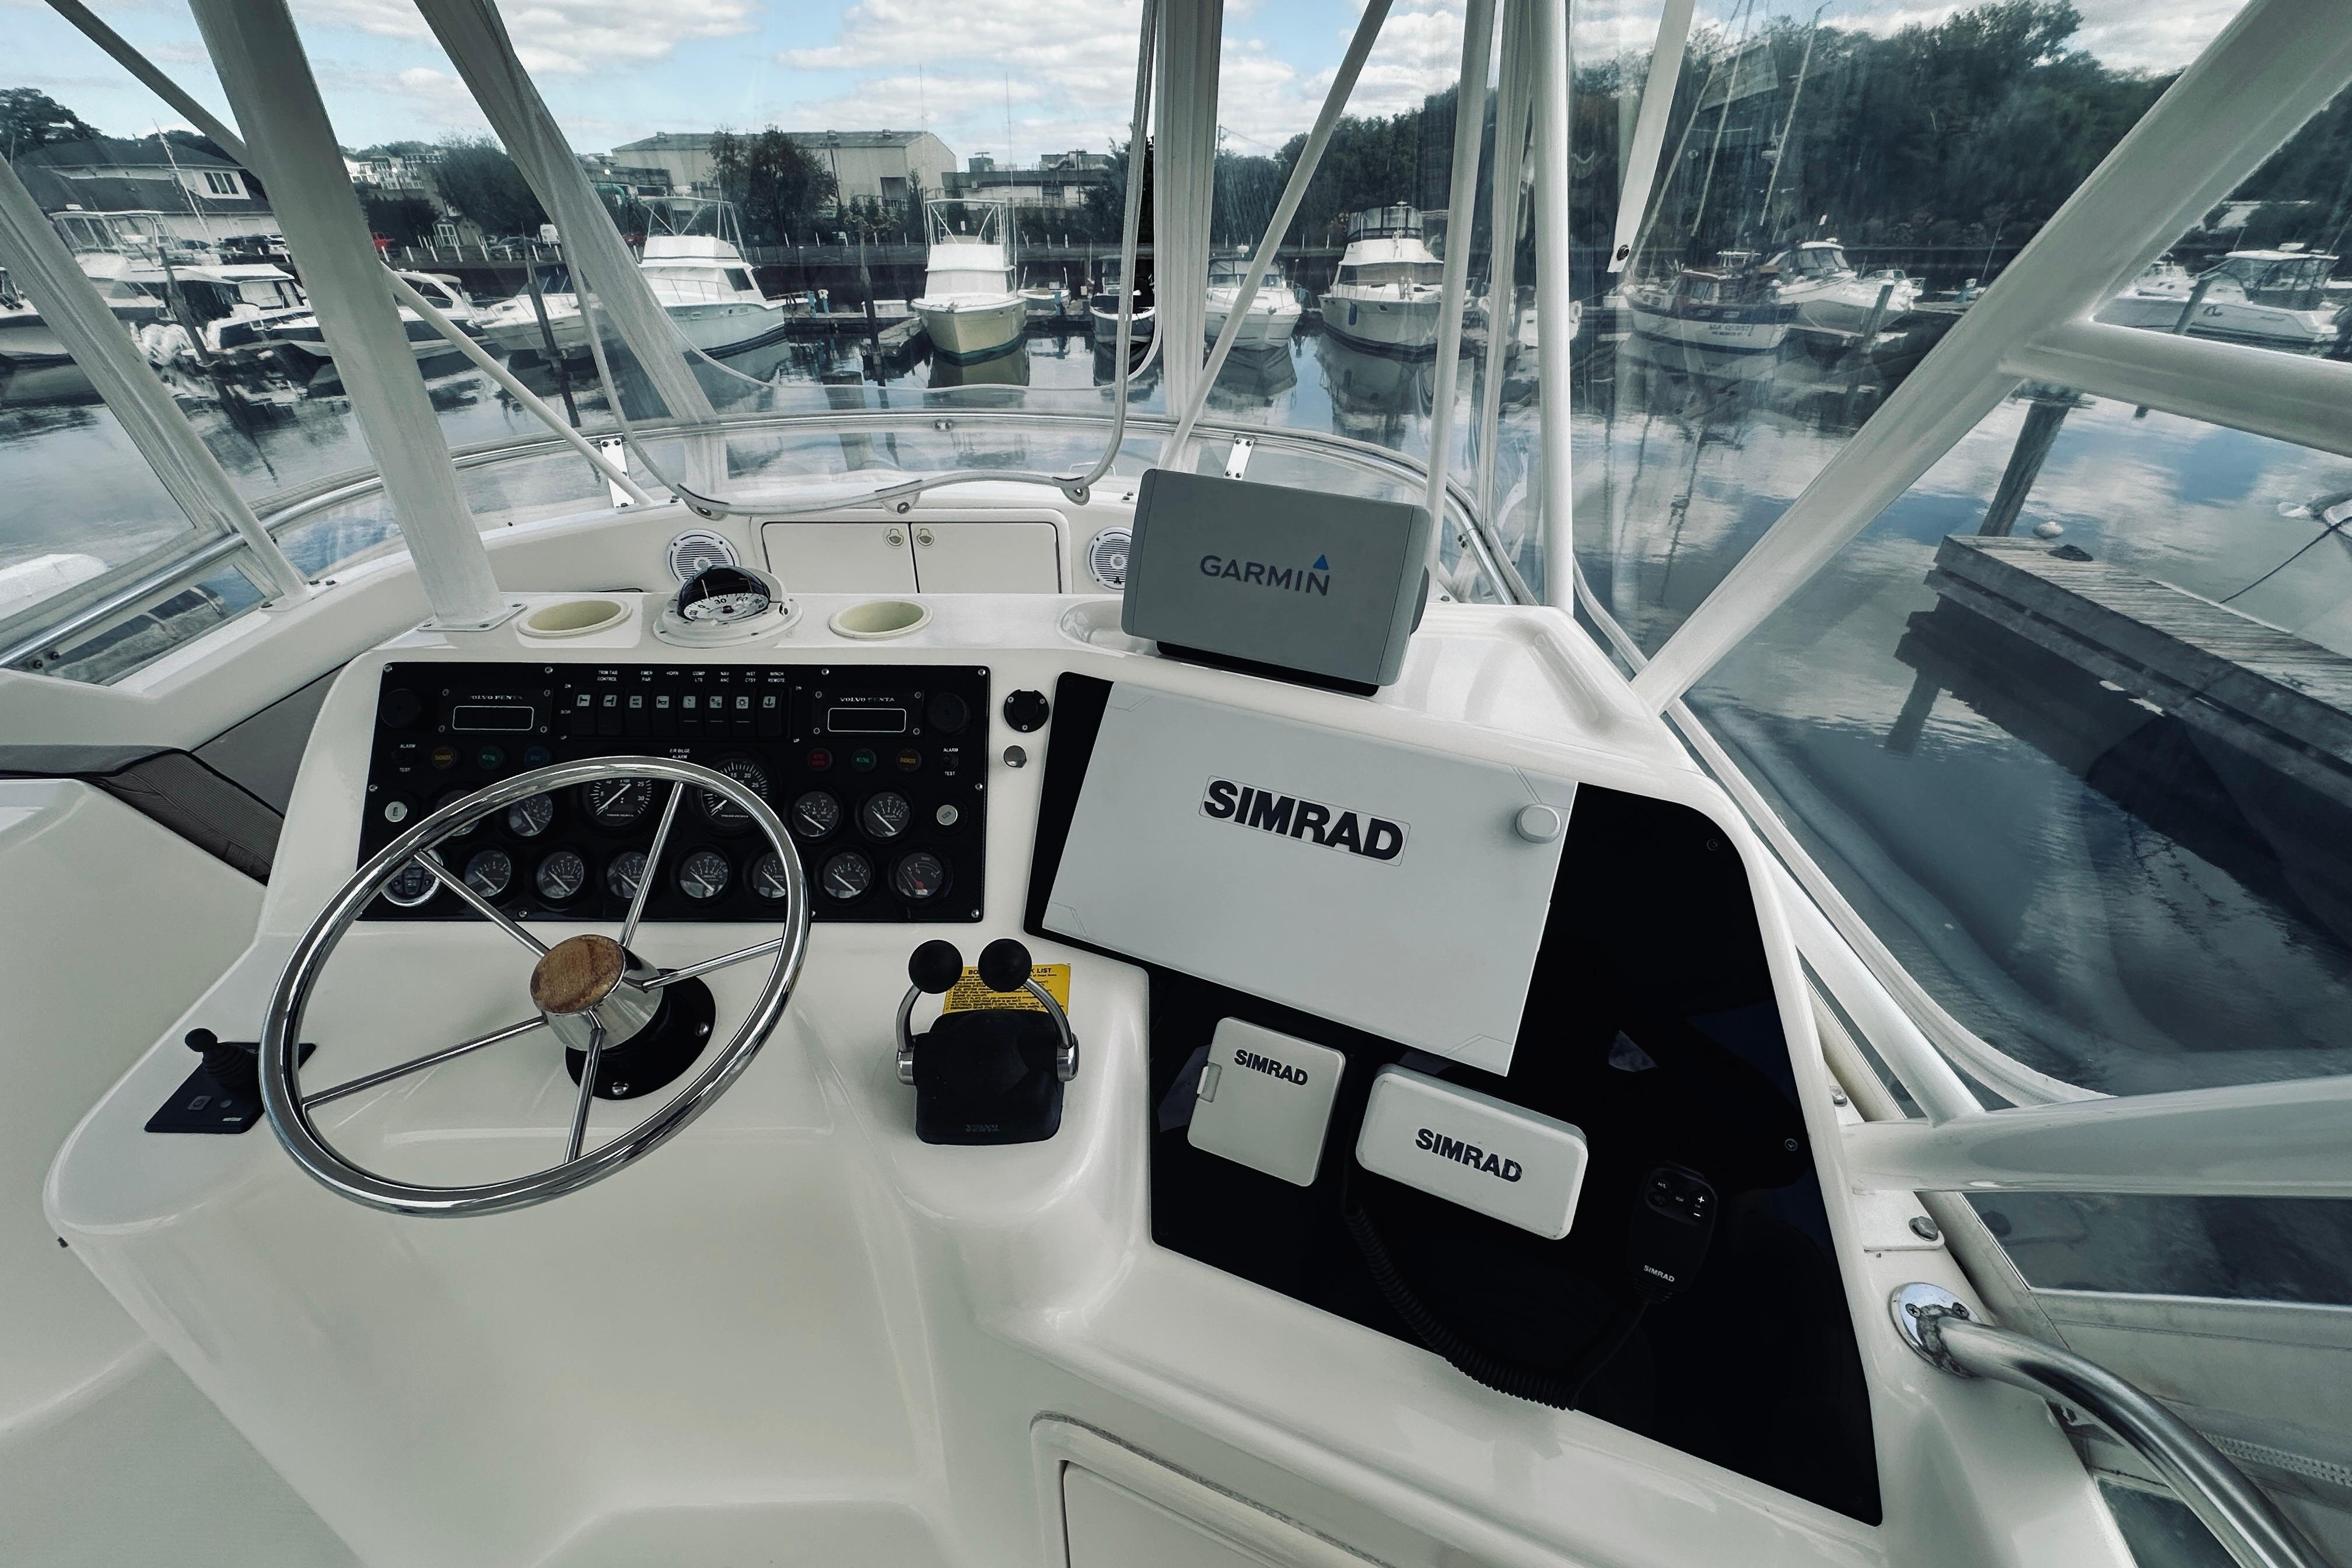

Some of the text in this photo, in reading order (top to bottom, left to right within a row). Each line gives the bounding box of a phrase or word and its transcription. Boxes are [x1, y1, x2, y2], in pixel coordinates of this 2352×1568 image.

[1200, 555, 1330, 596] GARMIN
[1203, 780, 1404, 860] SIMRAD
[1234, 1049, 1308, 1086] SIMRAD
[1415, 1128, 1522, 1182] SIMRAD
[1643, 1265, 1675, 1283] SIMRAD
